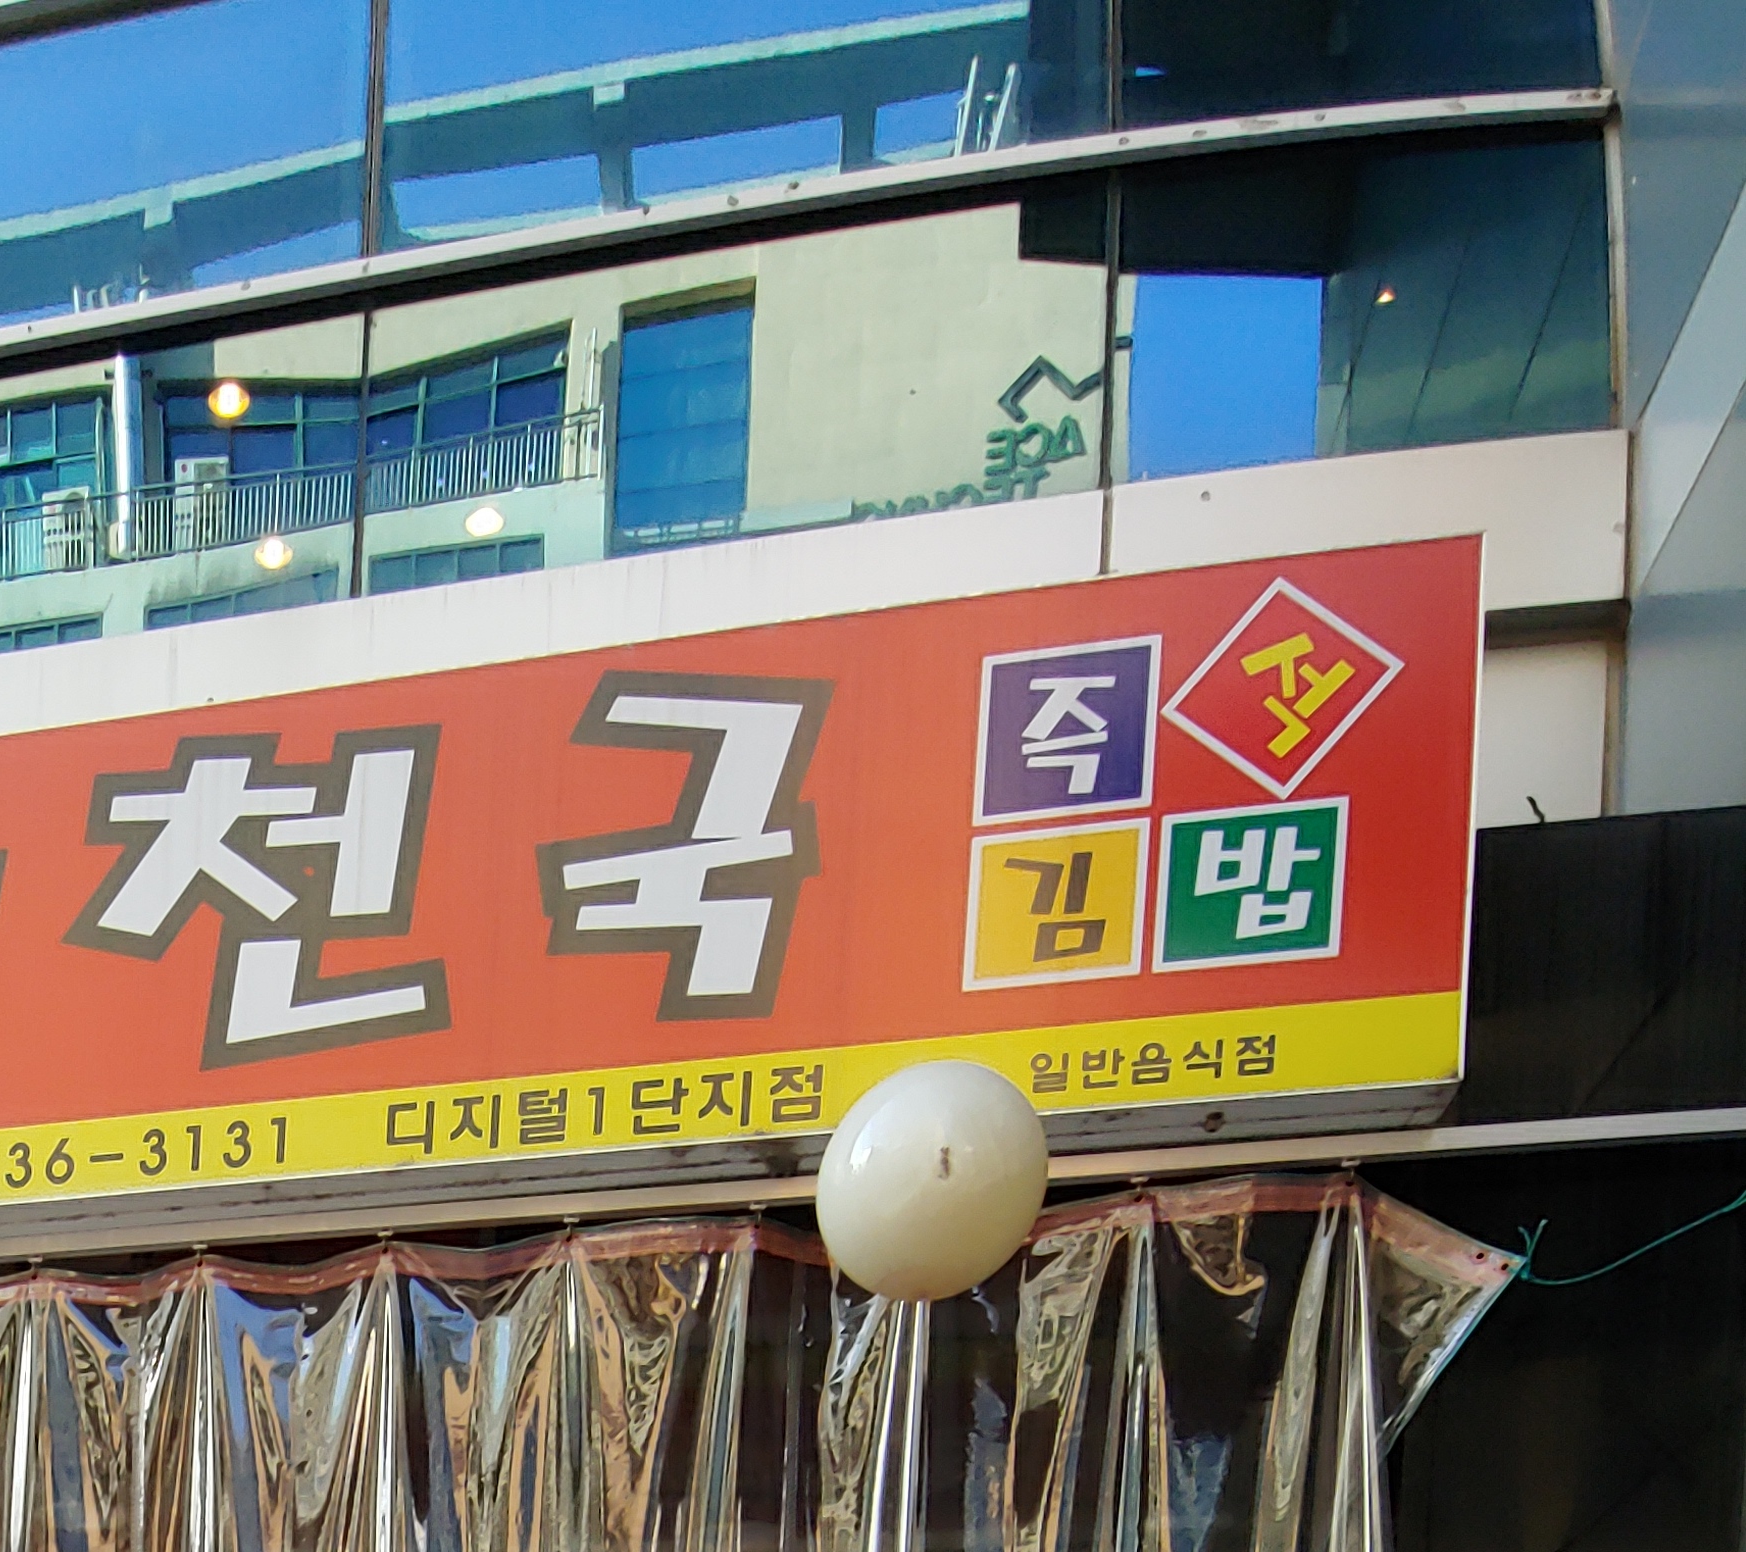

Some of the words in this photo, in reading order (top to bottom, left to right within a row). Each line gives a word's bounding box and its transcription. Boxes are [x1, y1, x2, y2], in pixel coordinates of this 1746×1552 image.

[1021, 676, 1117, 795] 죽
[1240, 632, 1356, 759] 전
[386, 1064, 824, 1154] 디지털1단지점
[1029, 1034, 1276, 1094] 일반음식점
